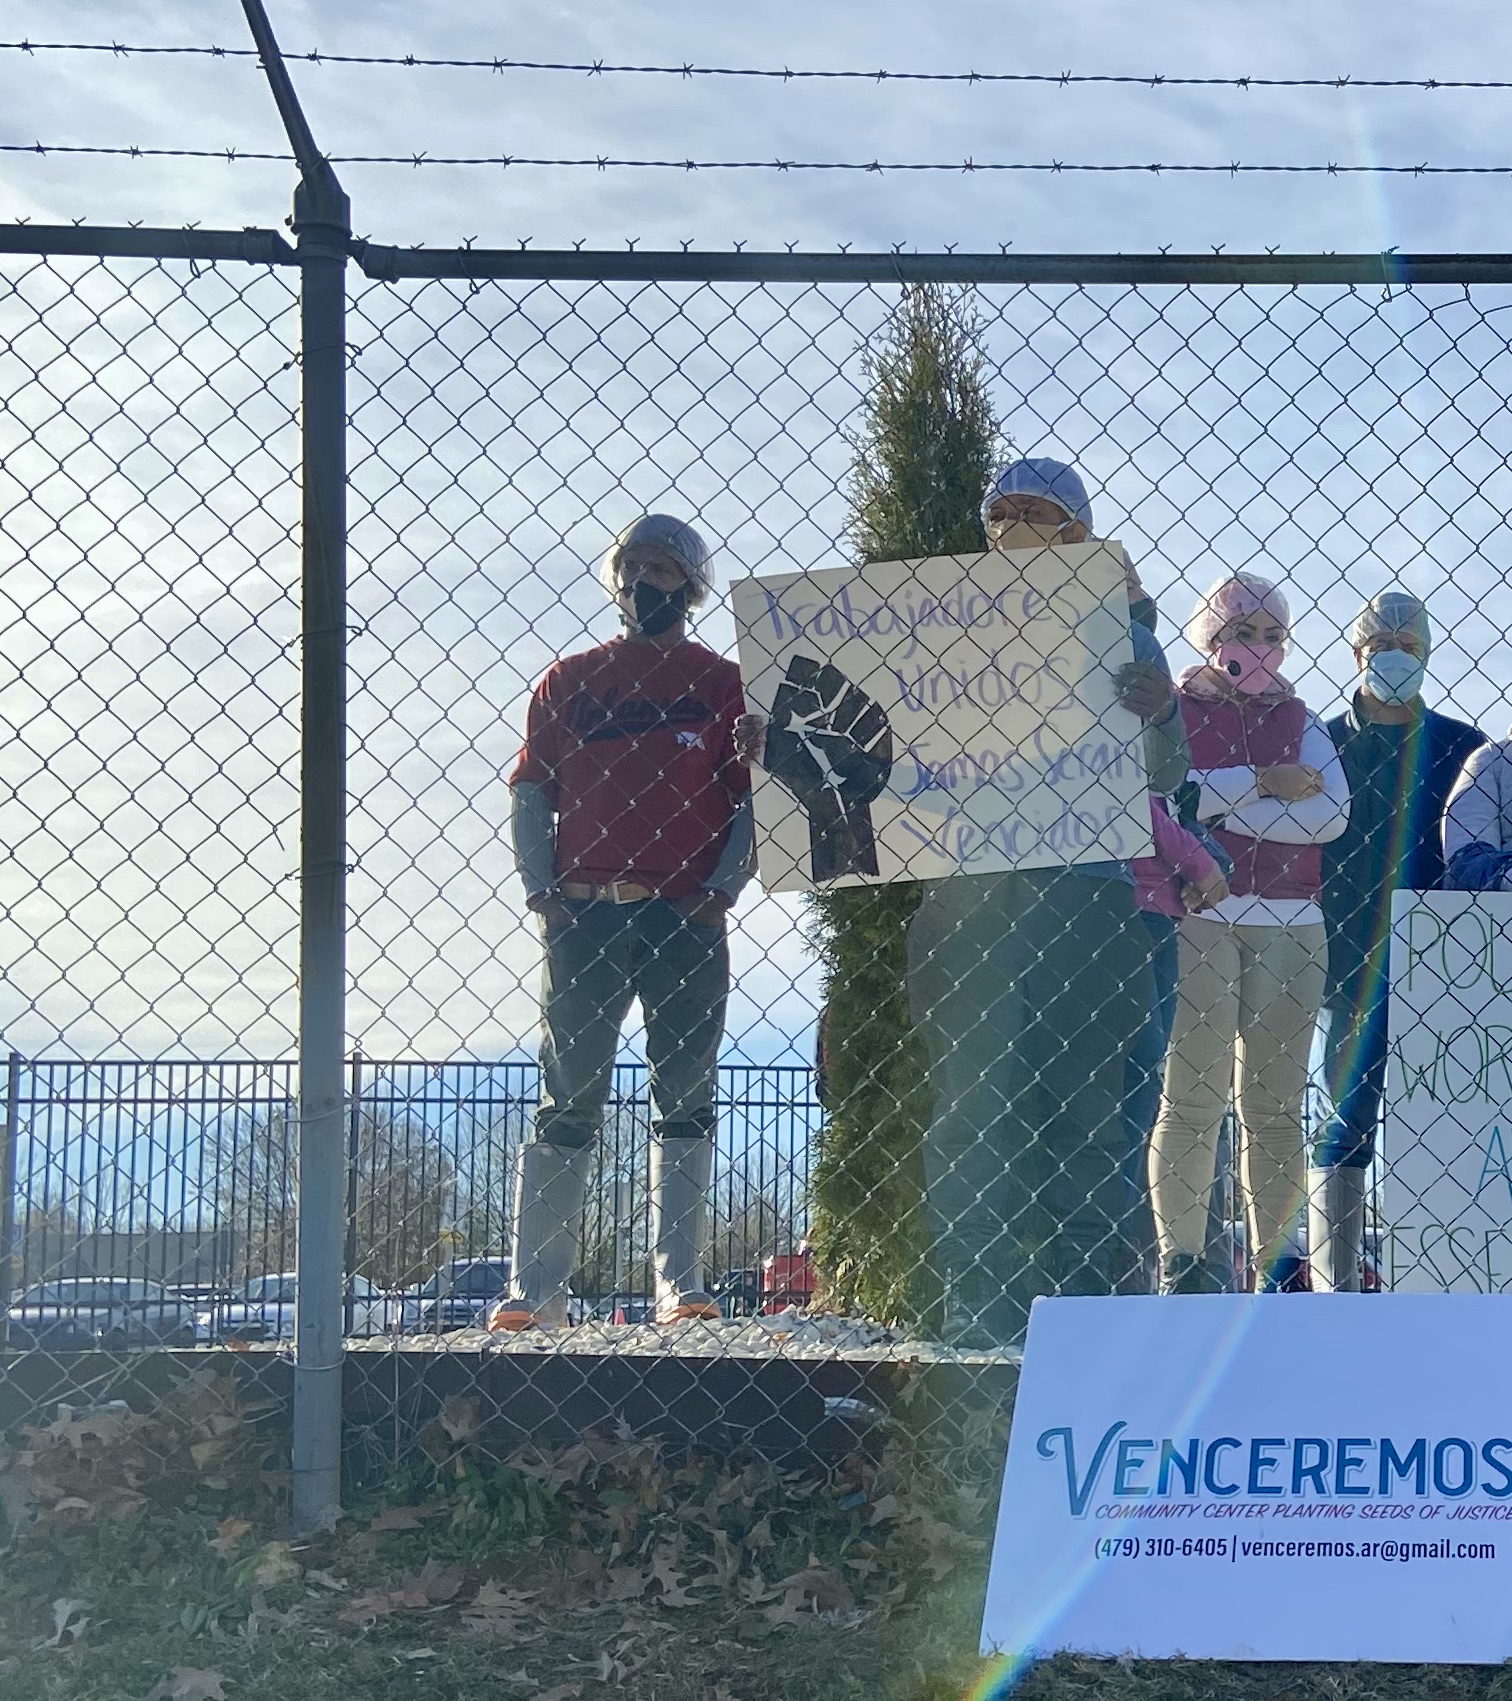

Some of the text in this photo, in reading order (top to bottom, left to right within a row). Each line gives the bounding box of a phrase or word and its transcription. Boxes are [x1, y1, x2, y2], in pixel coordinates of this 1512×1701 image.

[750, 583, 1081, 660] Trabajadores
[901, 801, 1125, 862] Vencidos
[1095, 1503, 1201, 1520] COMMUNITY
[1203, 1503, 1270, 1520] CENTER
[1272, 1503, 1355, 1520] PLANTING
[1358, 1504, 1415, 1520] SEEDS
[1418, 1504, 1445, 1520] OF
[1094, 1537, 1140, 1560] (479)
[1145, 1538, 1227, 1557] 310-6405
[1241, 1538, 1496, 1563] venceremos.ar@gmail.com
